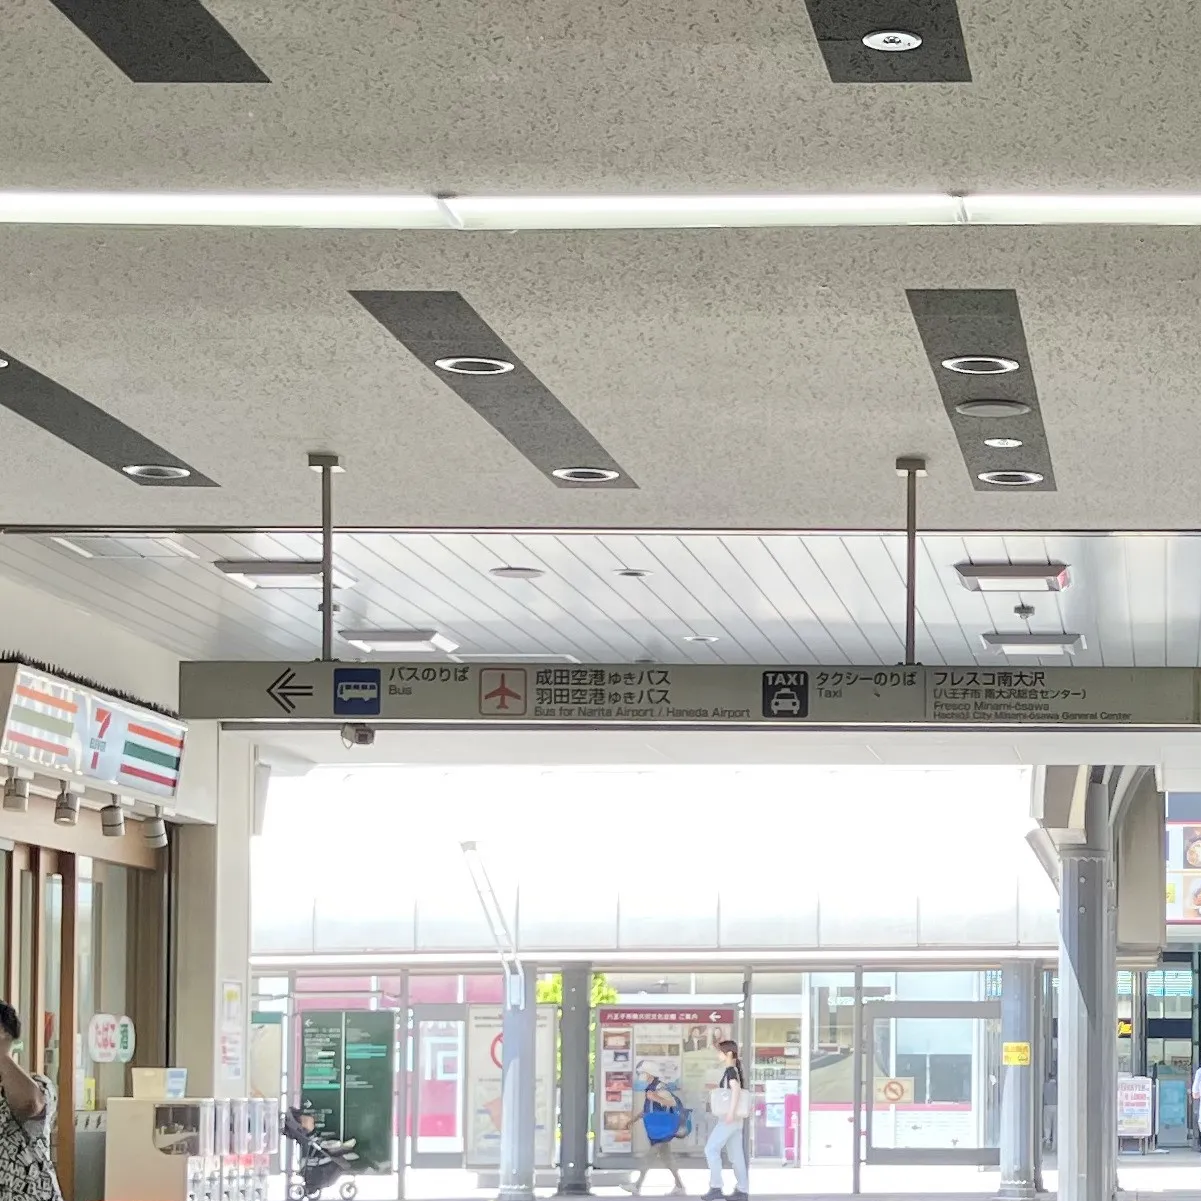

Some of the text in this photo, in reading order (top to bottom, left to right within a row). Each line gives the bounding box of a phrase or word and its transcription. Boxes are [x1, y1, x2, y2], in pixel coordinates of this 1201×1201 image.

[388, 666, 470, 683] バスのりば
[535, 669, 672, 686] 成田空港ゆきバス
[766, 673, 805, 686] TAXI
[815, 671, 917, 687] タクシーのりば
[933, 671, 1045, 688] フレスコ南大沢
[388, 685, 412, 696] Bus
[535, 688, 672, 705] 羽田空港ゆきバス
[817, 687, 843, 699] Taxi
[535, 707, 557, 718] Bus
[558, 706, 573, 718] for
[577, 706, 613, 718] Narita
[616, 706, 654, 719] Airport
[667, 707, 709, 718] Haneda
[712, 706, 751, 720] Airport
[933, 701, 971, 712] Fresco
